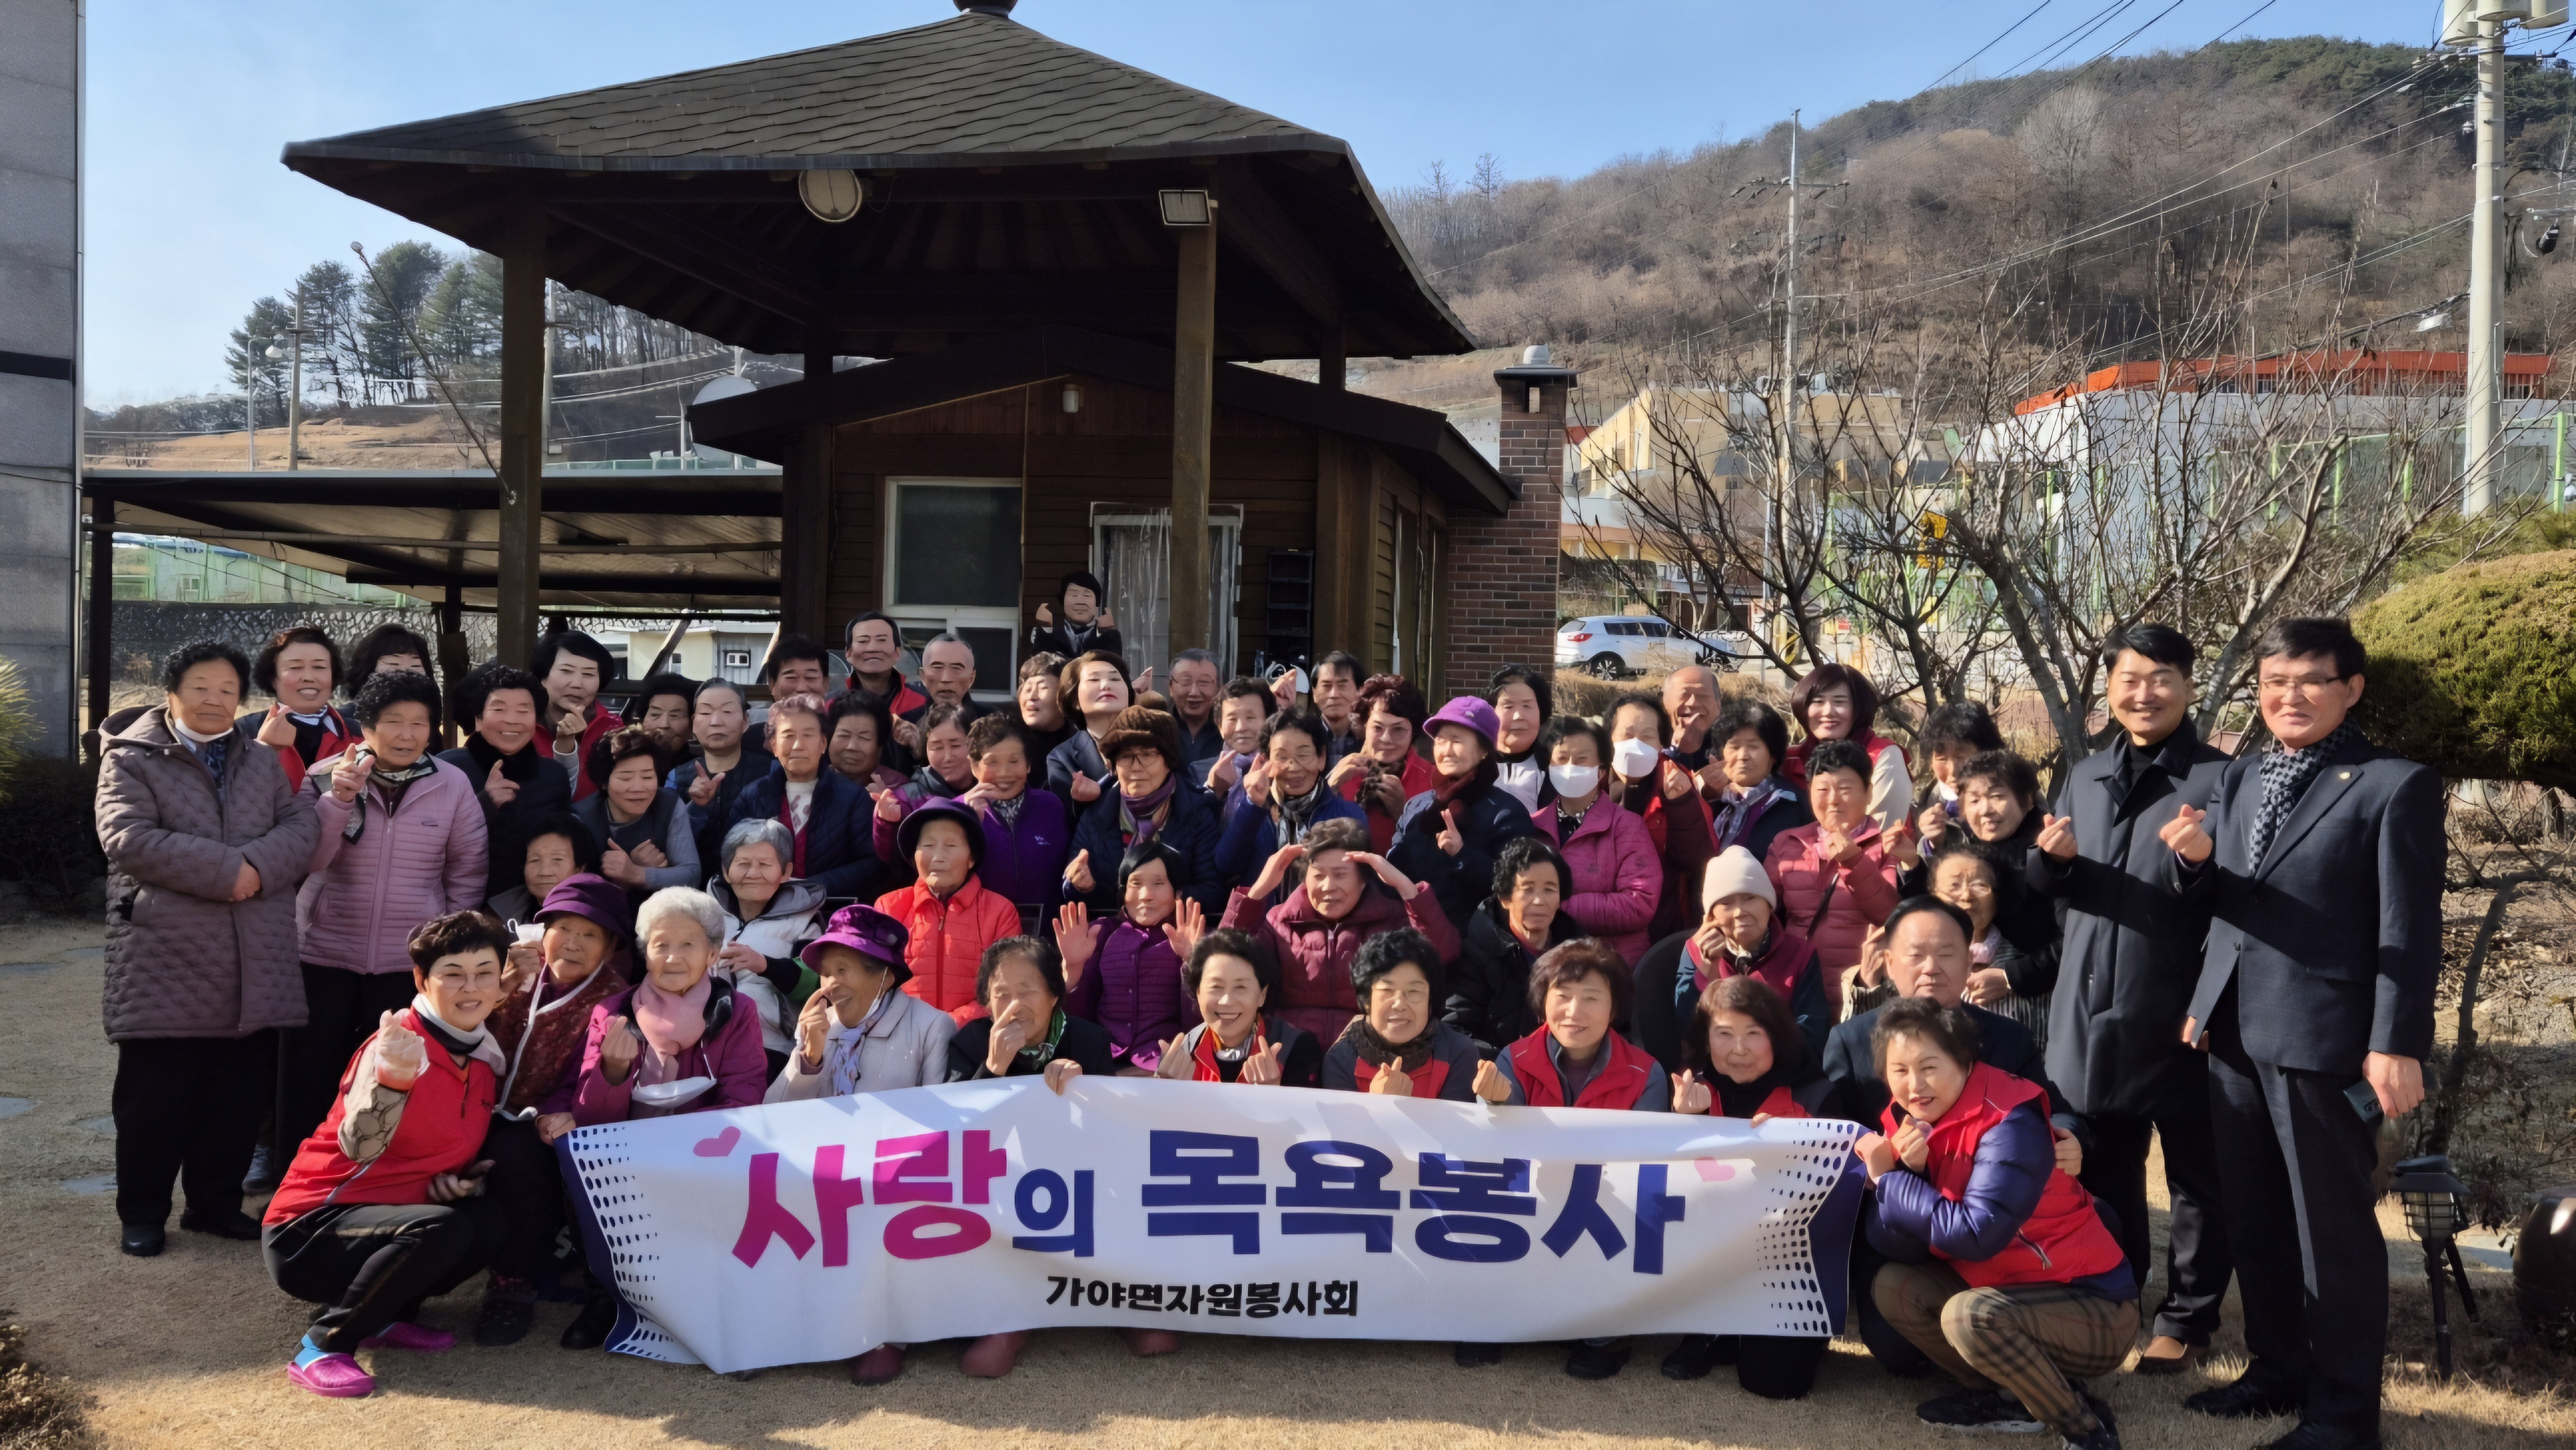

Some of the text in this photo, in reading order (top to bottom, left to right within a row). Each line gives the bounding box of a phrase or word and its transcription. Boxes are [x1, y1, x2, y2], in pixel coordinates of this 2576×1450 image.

[732, 1130, 1685, 1274] 사랑의 목욕봉사
[1046, 1276, 1358, 1318] 가야면자원봉사회
